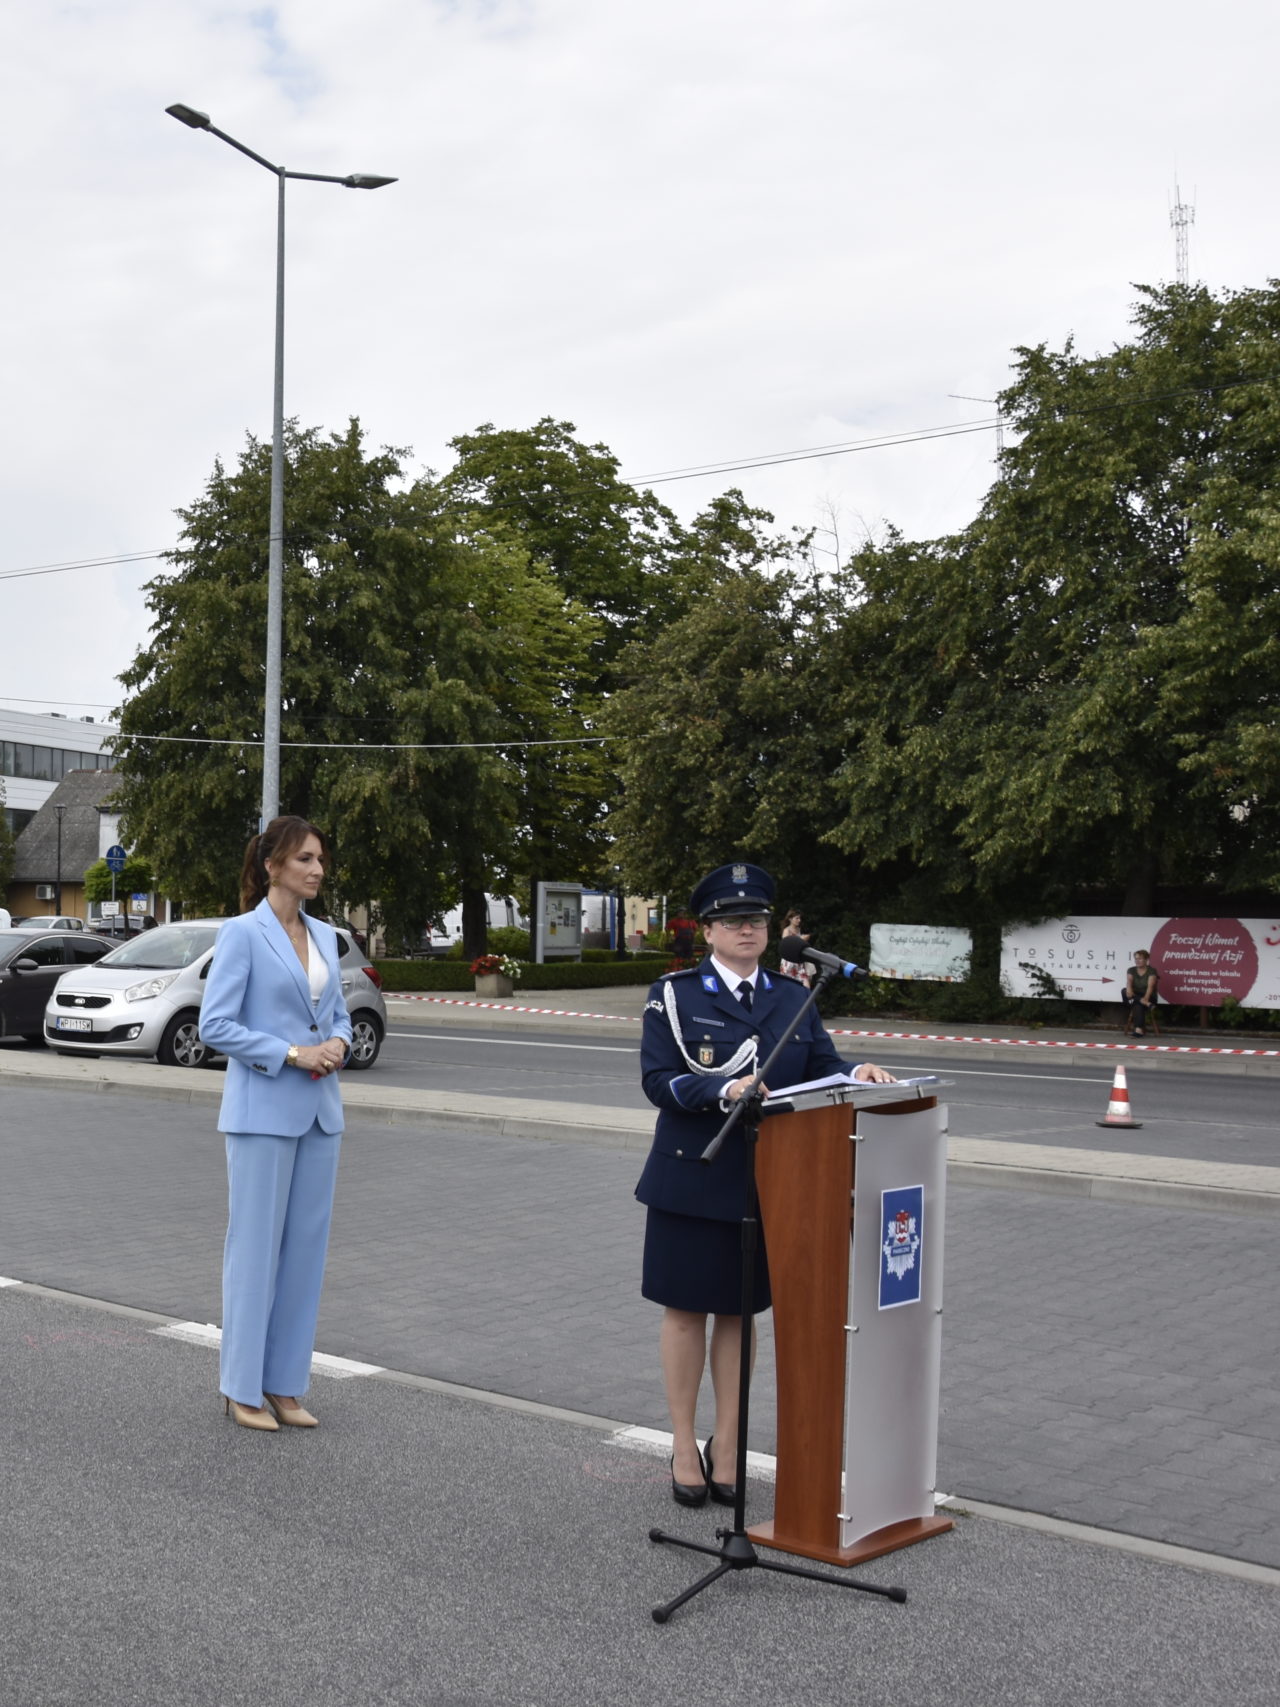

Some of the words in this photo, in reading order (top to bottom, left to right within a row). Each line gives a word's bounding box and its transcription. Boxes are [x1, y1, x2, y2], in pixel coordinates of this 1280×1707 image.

[1169, 933, 1205, 949] Poczuj
[1205, 933, 1240, 946] klimat
[1162, 948, 1221, 964] prawdziwej
[1221, 950, 1245, 965] Azji
